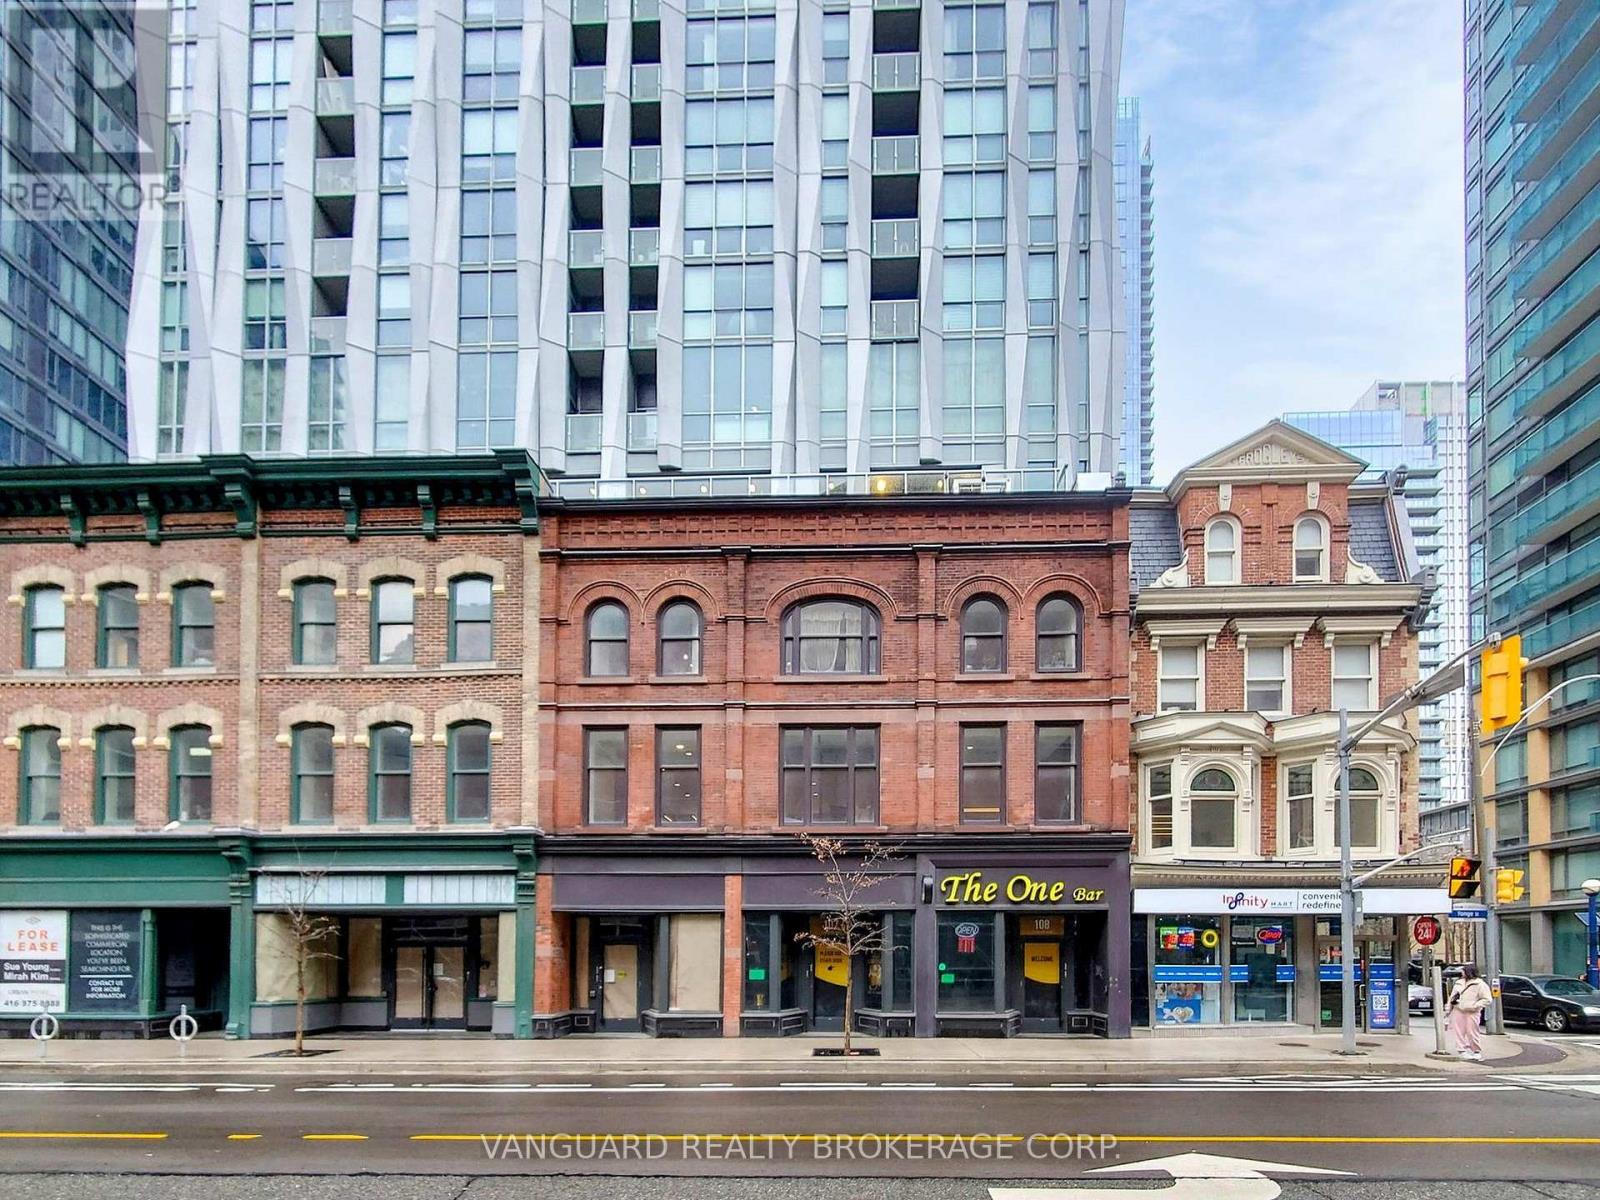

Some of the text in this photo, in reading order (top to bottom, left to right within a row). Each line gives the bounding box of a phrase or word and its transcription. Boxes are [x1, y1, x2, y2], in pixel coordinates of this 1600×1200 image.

[940, 871, 1104, 903] The One Bar
[1222, 892, 1268, 910] Infinity
[1034, 919, 1050, 930] 108
[18, 930, 48, 939] FOR
[8, 942, 58, 951] LEASE
[3, 962, 51, 973] Sue Young
[3, 971, 49, 980] Mirah Kim
